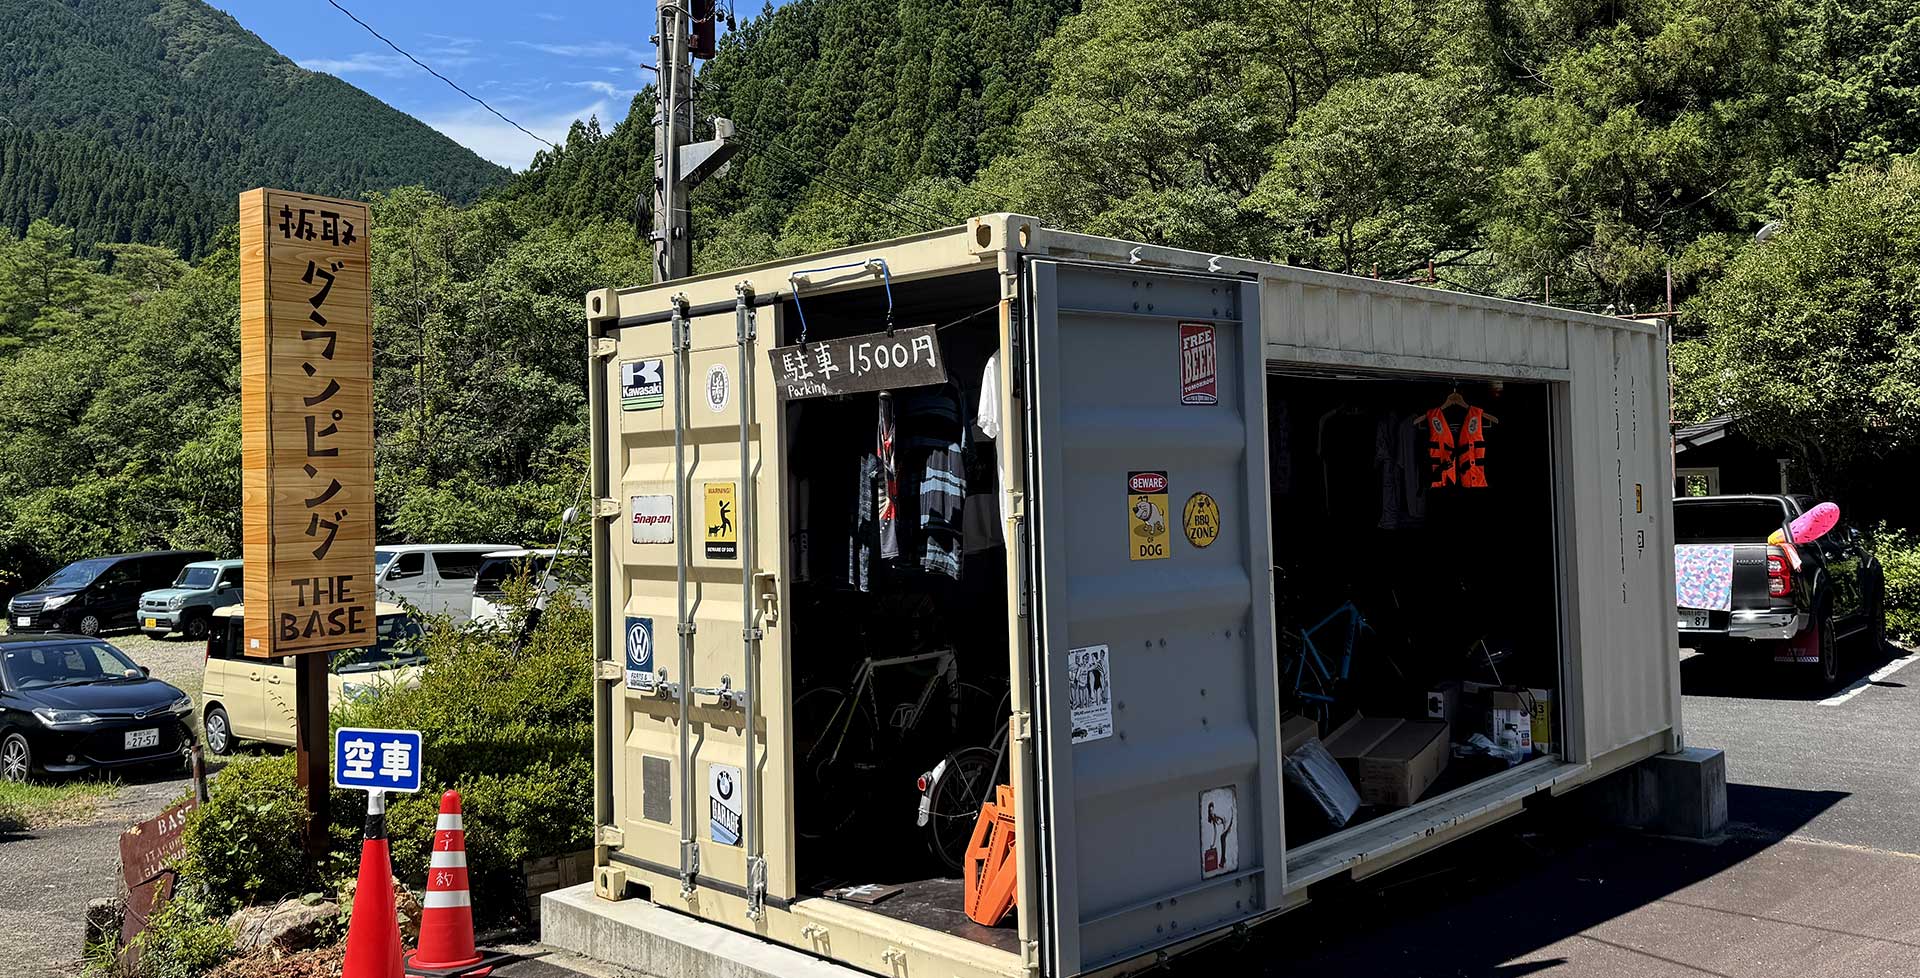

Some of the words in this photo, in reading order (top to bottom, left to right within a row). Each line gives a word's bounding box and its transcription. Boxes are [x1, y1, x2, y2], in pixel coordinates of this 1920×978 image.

[279, 204, 357, 246] 板取
[1183, 330, 1212, 350] FREE
[783, 342, 839, 382] 駐車
[1183, 343, 1214, 385] BEER
[622, 383, 662, 398] Kawasaki
[787, 382, 828, 398] Parking
[1184, 377, 1215, 392] TOMORROW
[301, 259, 349, 561] グランピング
[1132, 478, 1163, 488] BEWARE
[632, 512, 671, 526] Snap-on
[1194, 515, 1210, 527] BBQ
[1190, 527, 1215, 539] ZONE
[1140, 544, 1162, 556] DOG
[291, 575, 354, 607] THE
[280, 605, 366, 643] BASE
[1694, 616, 1707, 626] 87
[132, 735, 157, 747] 27-57
[343, 738, 412, 782] 空車
[712, 798, 739, 837] GARAGE
